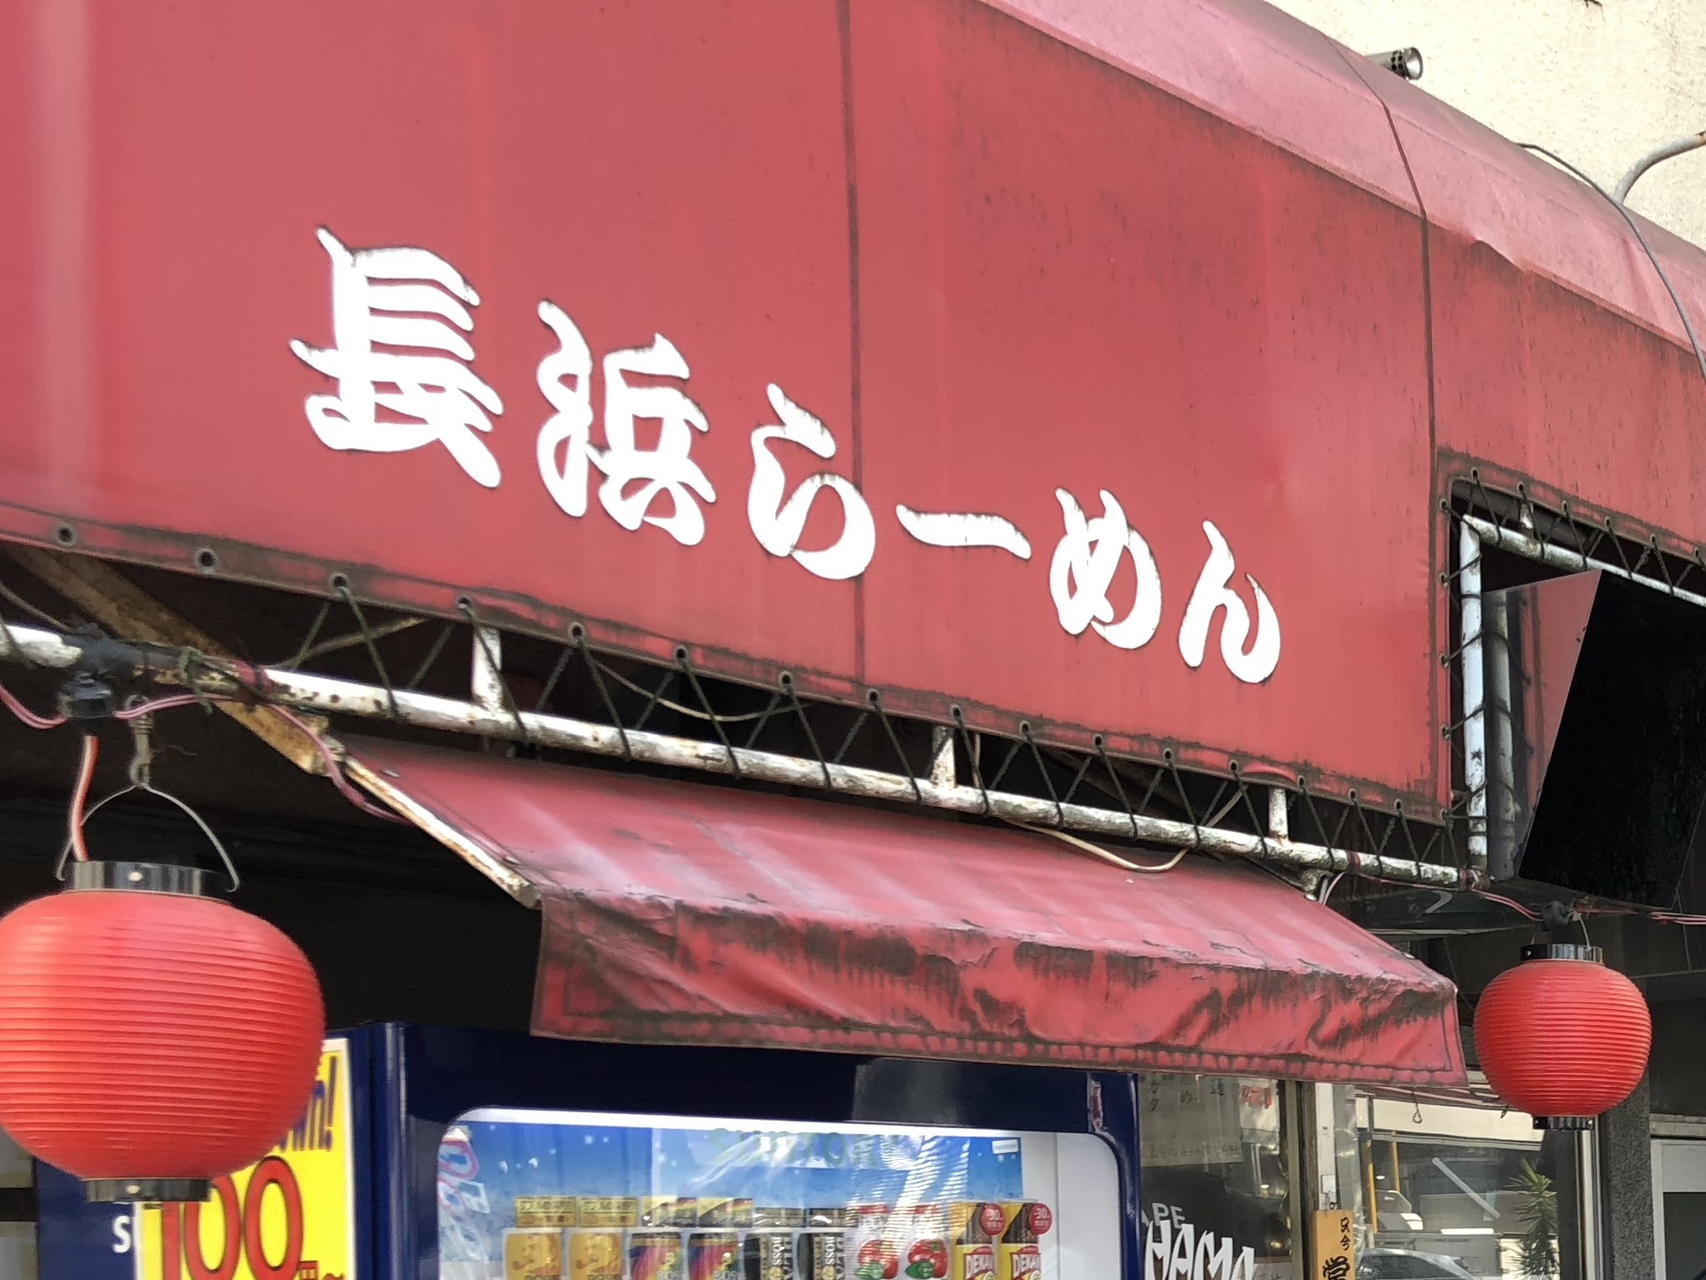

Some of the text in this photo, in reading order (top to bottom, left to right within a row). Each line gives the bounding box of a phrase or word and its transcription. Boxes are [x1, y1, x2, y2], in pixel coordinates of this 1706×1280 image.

[289, 225, 1281, 684] 長浜らーめん
